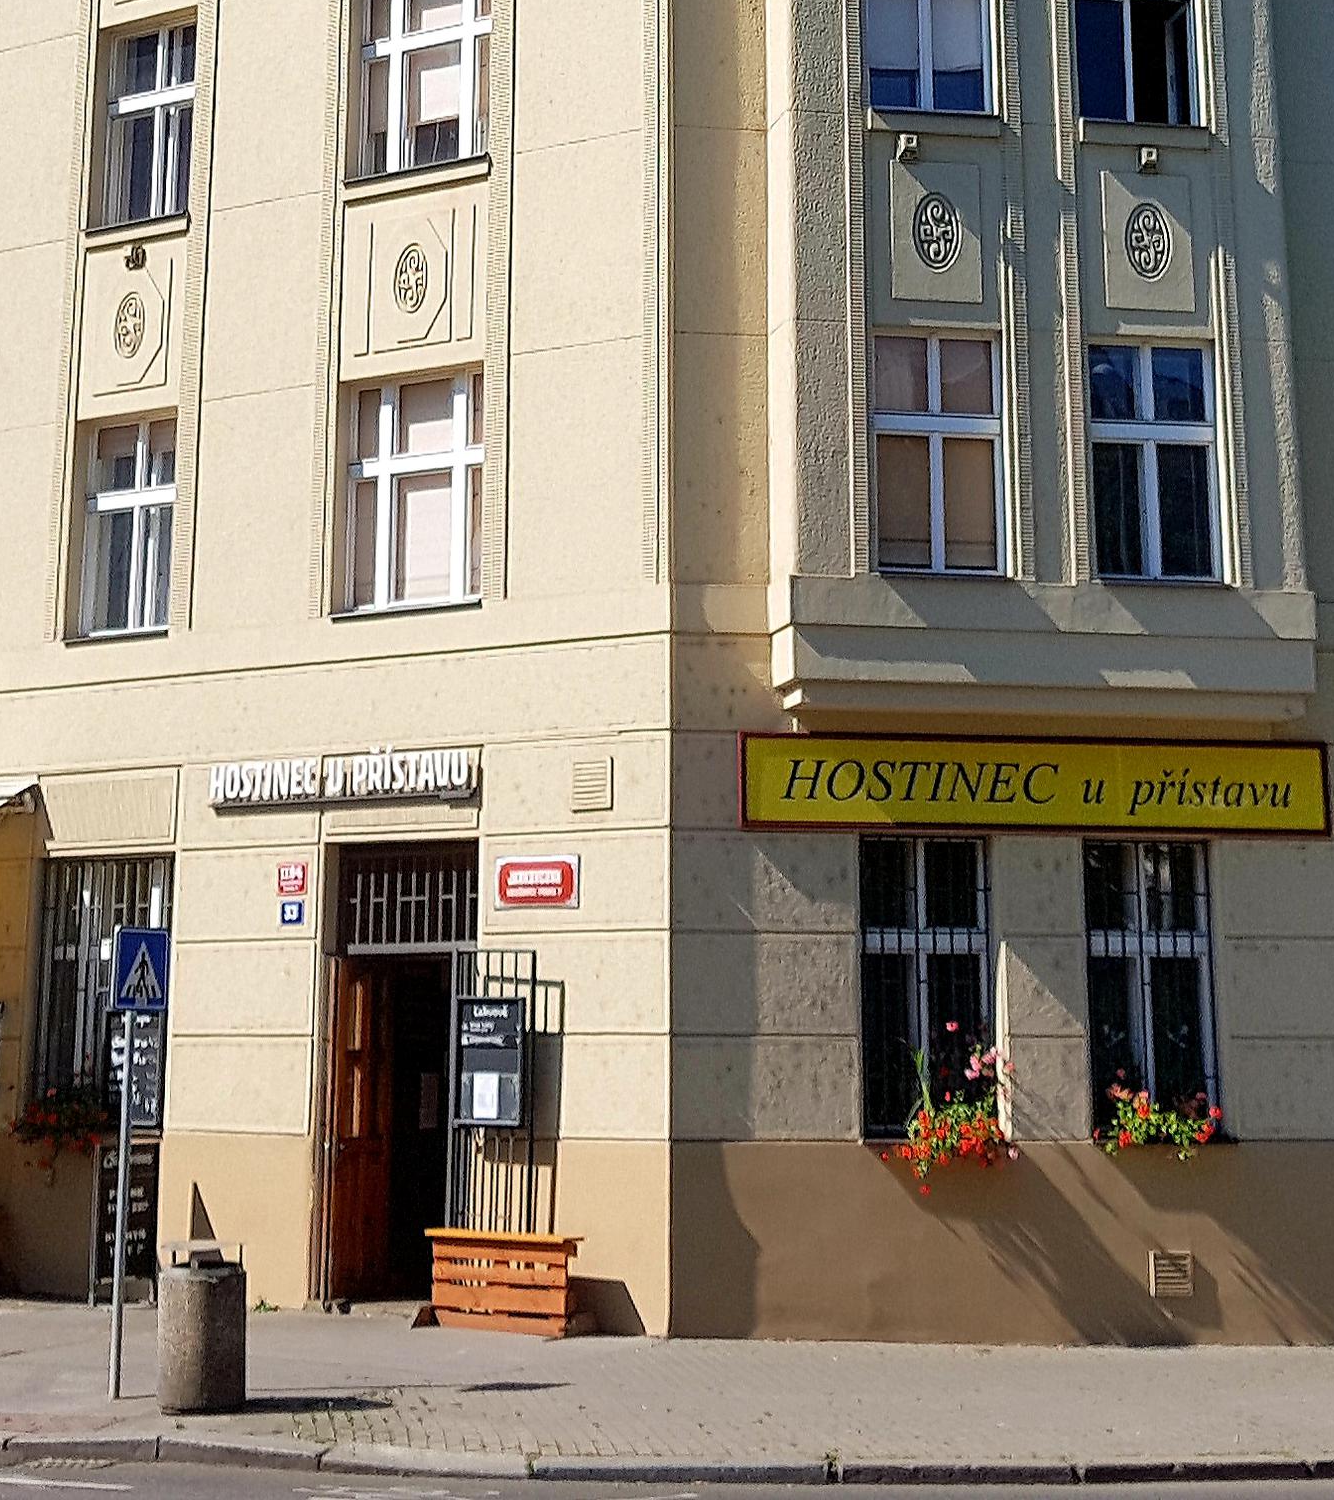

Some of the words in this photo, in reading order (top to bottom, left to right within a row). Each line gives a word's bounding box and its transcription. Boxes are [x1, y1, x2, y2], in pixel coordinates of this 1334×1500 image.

[208, 759, 318, 801] HOSTINEC
[324, 756, 345, 795] U
[352, 745, 469, 794] PŘÍSTAVU
[781, 758, 1061, 806] HOSTINEC
[1080, 774, 1106, 804] u
[1126, 767, 1293, 817] přístavu
